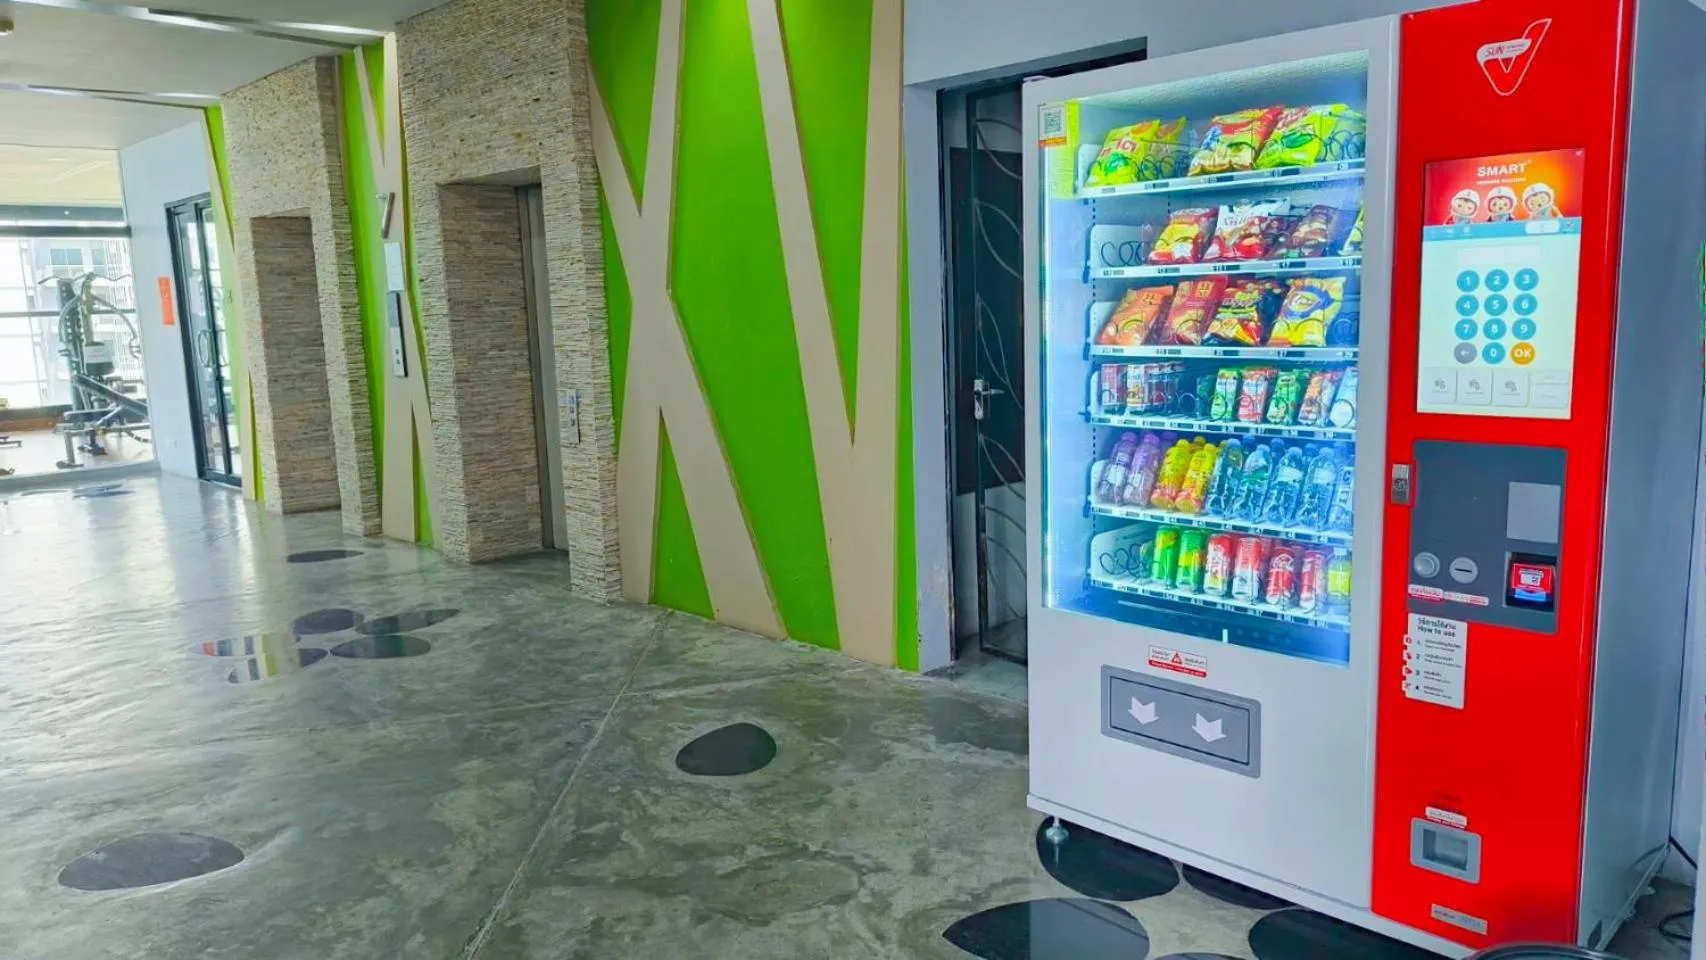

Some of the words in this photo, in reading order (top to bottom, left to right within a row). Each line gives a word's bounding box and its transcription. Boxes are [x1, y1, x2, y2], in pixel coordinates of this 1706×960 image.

[1485, 45, 1506, 57] SUN
[1478, 163, 1526, 177] SMART
[1493, 275, 1501, 285] 2
[1522, 274, 1531, 284] 3
[1463, 301, 1471, 310] 4
[1492, 300, 1500, 309] 5
[1521, 299, 1529, 309] 6
[1462, 324, 1470, 333] 7
[1490, 324, 1498, 334] 8
[1520, 324, 1528, 334] 9
[1489, 348, 1497, 358] 0
[1514, 348, 1532, 358] OK
[1417, 625, 1433, 634] How
[1443, 630, 1456, 638] use
